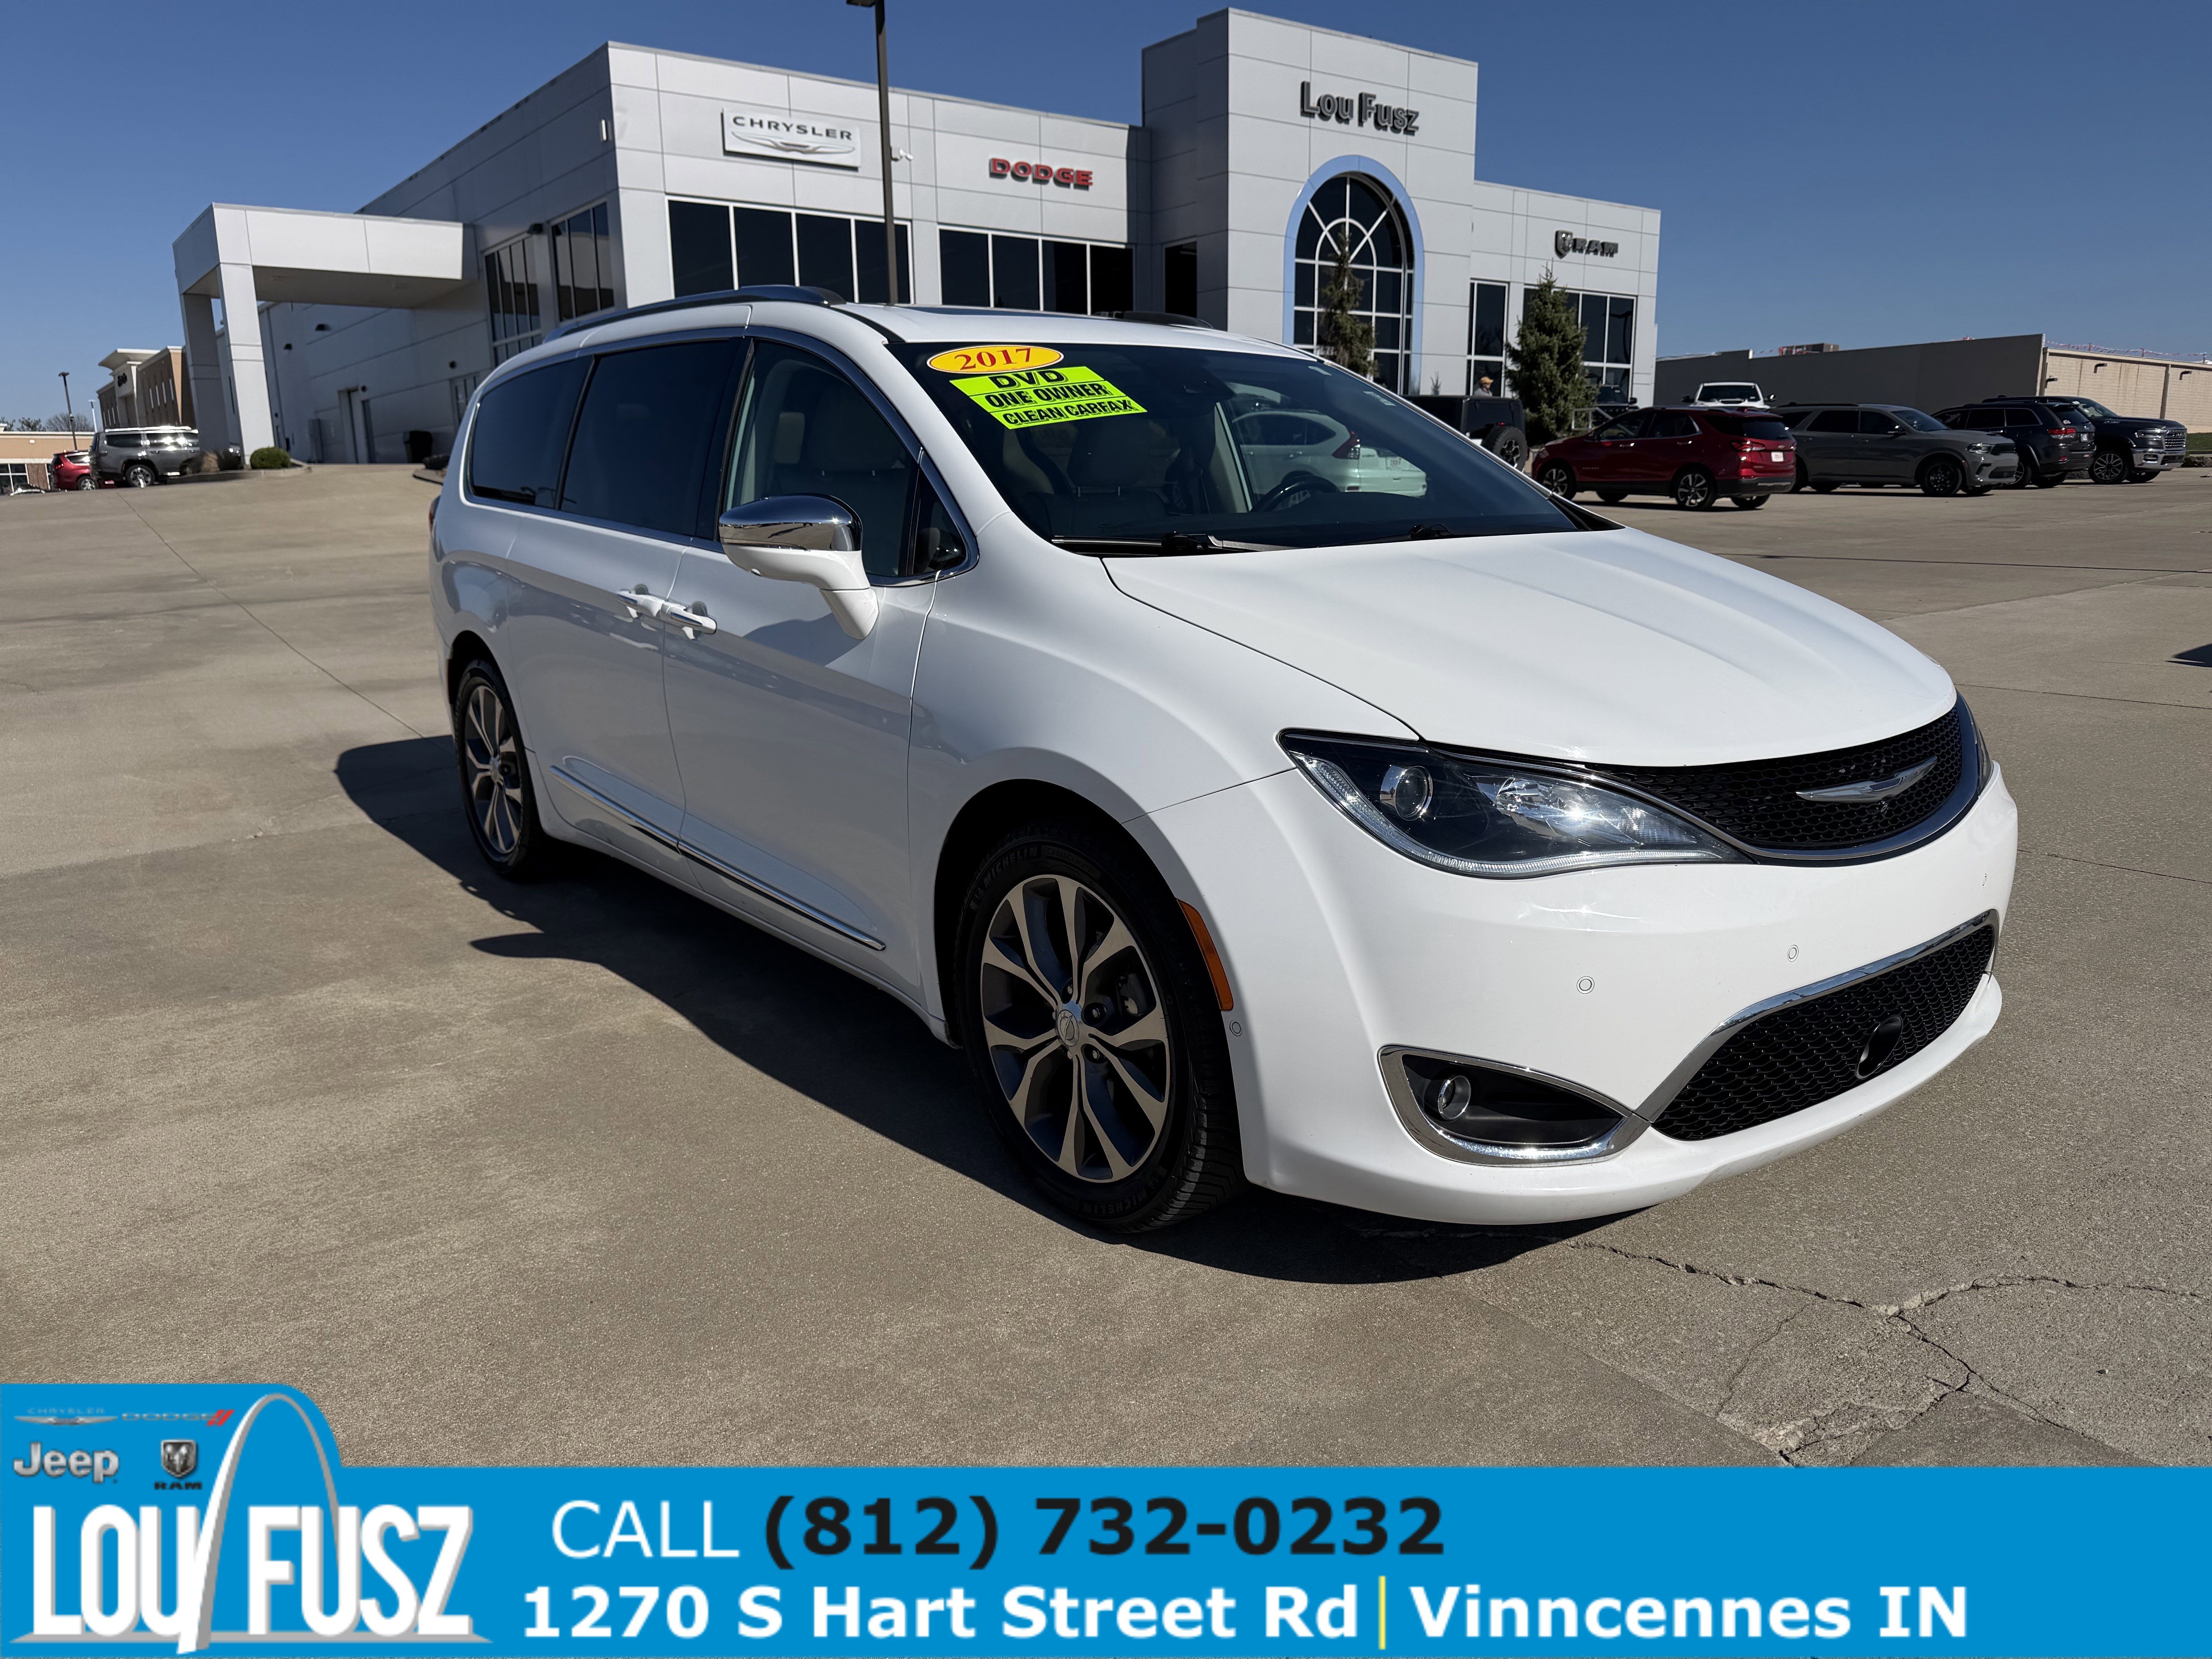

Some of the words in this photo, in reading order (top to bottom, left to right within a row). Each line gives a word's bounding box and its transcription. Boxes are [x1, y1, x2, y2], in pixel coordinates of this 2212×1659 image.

[1301, 81, 1353, 120] Lou
[1359, 92, 1419, 134] Fusz
[733, 116, 852, 141] CHRYSLER
[989, 157, 1093, 190] DODGE
[1572, 238, 1618, 257] RAM
[954, 348, 1032, 371] 2017
[988, 369, 1066, 388] DVD
[984, 390, 1033, 408] ONE
[1033, 383, 1108, 402] OWNER
[1002, 405, 1065, 425] CLEAN
[1064, 399, 1134, 417] CARFAX
[983, 846, 1038, 888] MICHELIN
